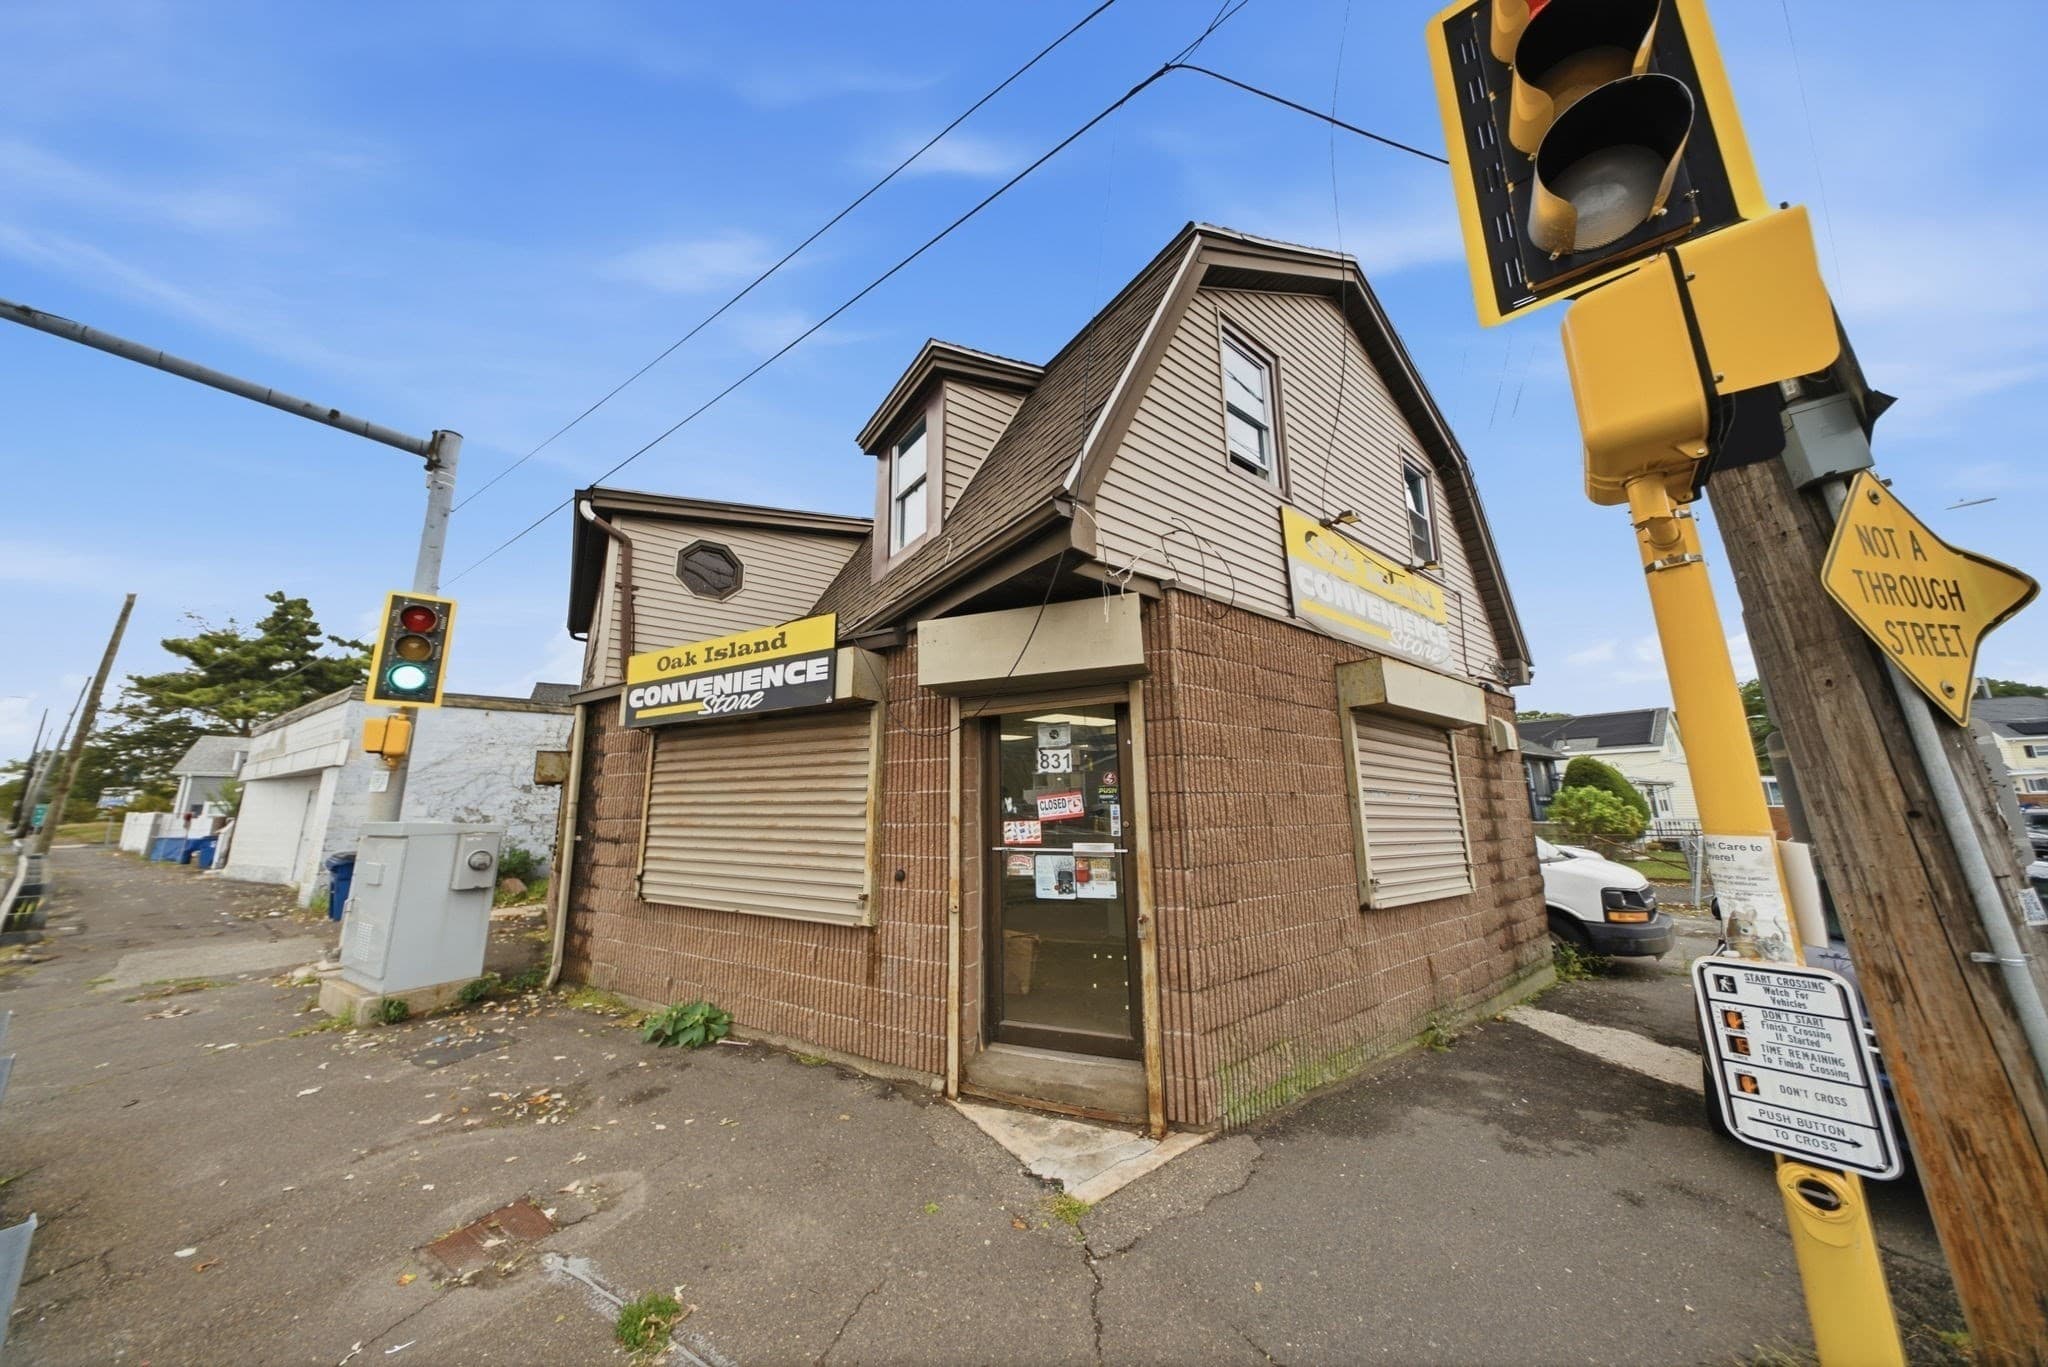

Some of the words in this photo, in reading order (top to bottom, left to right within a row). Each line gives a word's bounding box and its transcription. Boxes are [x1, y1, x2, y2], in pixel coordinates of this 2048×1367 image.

[1855, 524, 1901, 560] NOT
[1908, 530, 1928, 562] A
[1852, 569, 1966, 612] THROUGH
[1295, 567, 1448, 646] CONVENIENCE
[1884, 620, 1968, 658] STREET
[656, 655, 698, 673] Oak
[703, 632, 787, 663] Island
[629, 656, 829, 708] CONVENIENCE
[698, 690, 764, 715] Store
[1040, 753, 1070, 769] 831
[1040, 798, 1067, 811] CLOSED
[1718, 842, 1747, 851] Care
[1750, 844, 1763, 852] to
[1744, 973, 1771, 984] START
[1776, 977, 1825, 991] CROSSING
[1762, 986, 1790, 998] Watch
[1795, 990, 1809, 1000] For
[1769, 996, 1807, 1009] Vehicles
[1761, 1009, 1790, 1021] DON'T
[1794, 1015, 1824, 1027] START
[1761, 1020, 1788, 1032] Finish
[1793, 1025, 1832, 1042] Crossing
[1787, 1034, 1821, 1048] Started
[1760, 1044, 1783, 1056] TIME
[1788, 1049, 1846, 1067] REMAINING
[1761, 1054, 1773, 1064] To
[1778, 1057, 1804, 1070] Finish
[1809, 1063, 1850, 1081] Crossing
[1779, 1084, 1809, 1099] DON'T
[1814, 1092, 1848, 1107] CROSS
[1758, 1108, 1792, 1124] PUSH
[1796, 1117, 1846, 1137] BUTTON
[1773, 1128, 1790, 1140] TO
[1794, 1134, 1838, 1152] CROSS
